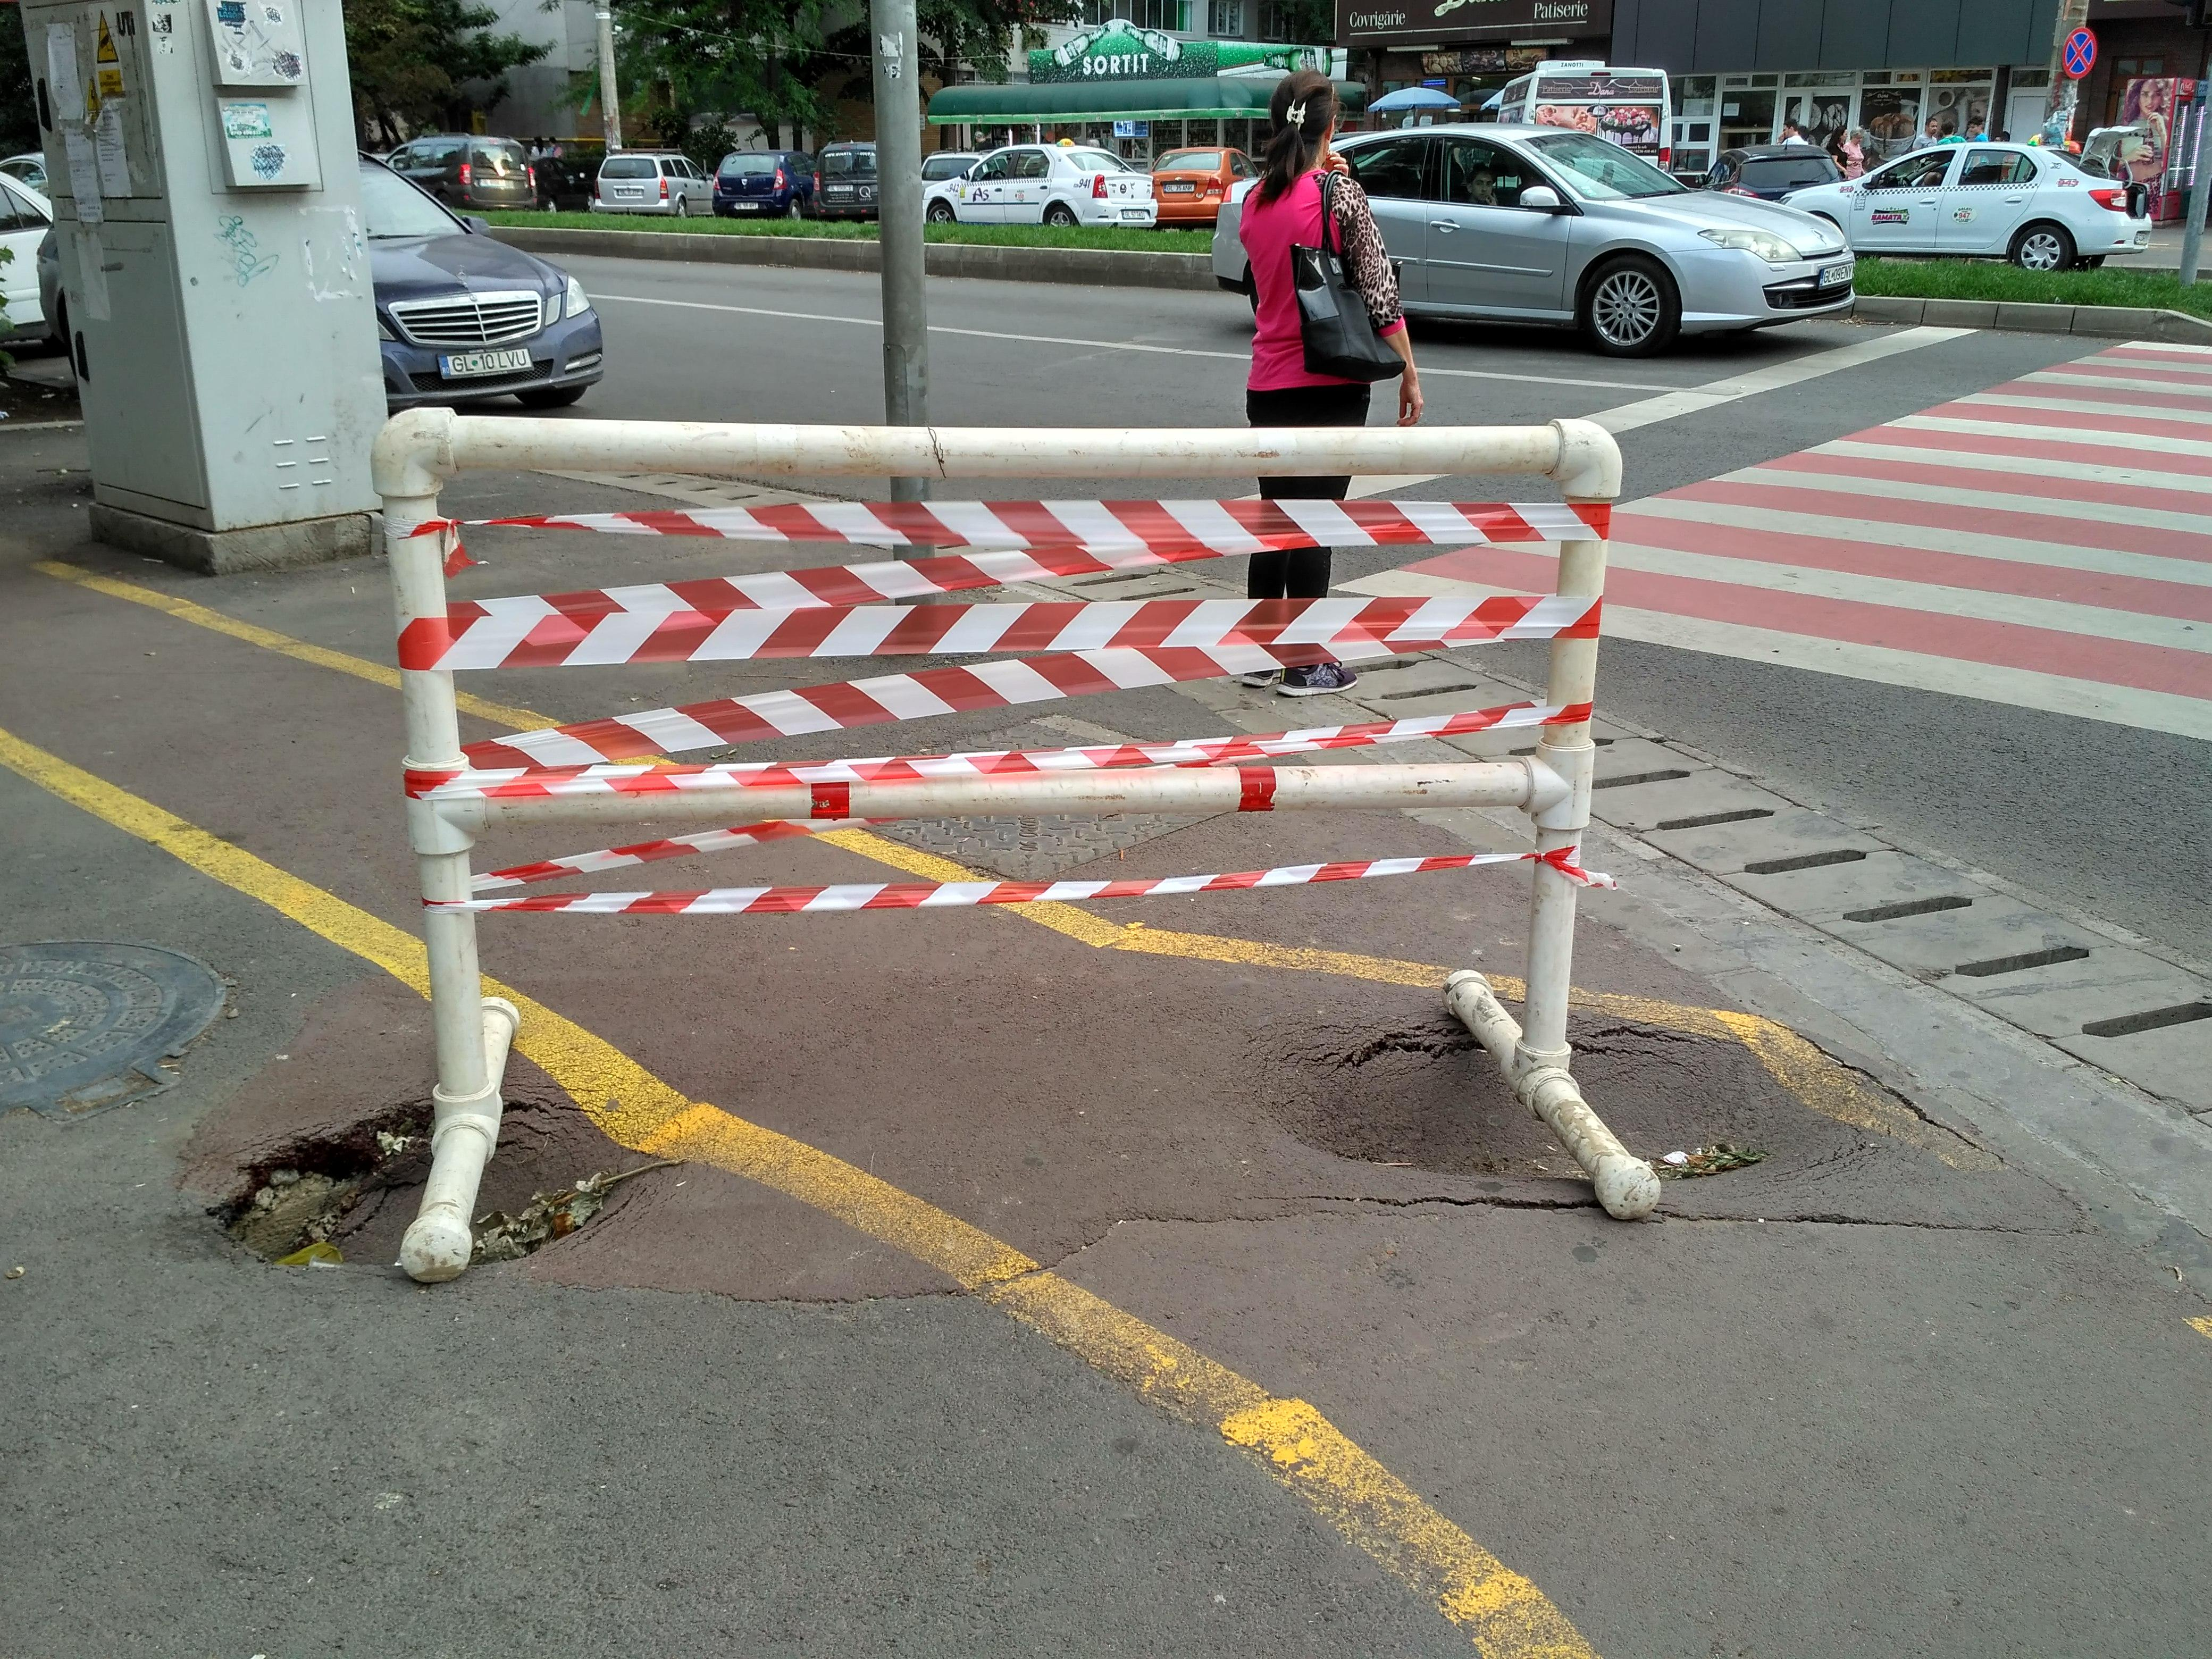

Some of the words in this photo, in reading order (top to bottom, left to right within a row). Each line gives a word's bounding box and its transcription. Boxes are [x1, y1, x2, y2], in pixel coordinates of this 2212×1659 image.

[1534, 0, 1588, 19] Patiserie
[1083, 54, 1149, 75] SORTIT
[1079, 178, 1091, 189] 941
[453, 356, 474, 372] GL
[479, 354, 495, 370] 10
[497, 350, 527, 368] LVU
